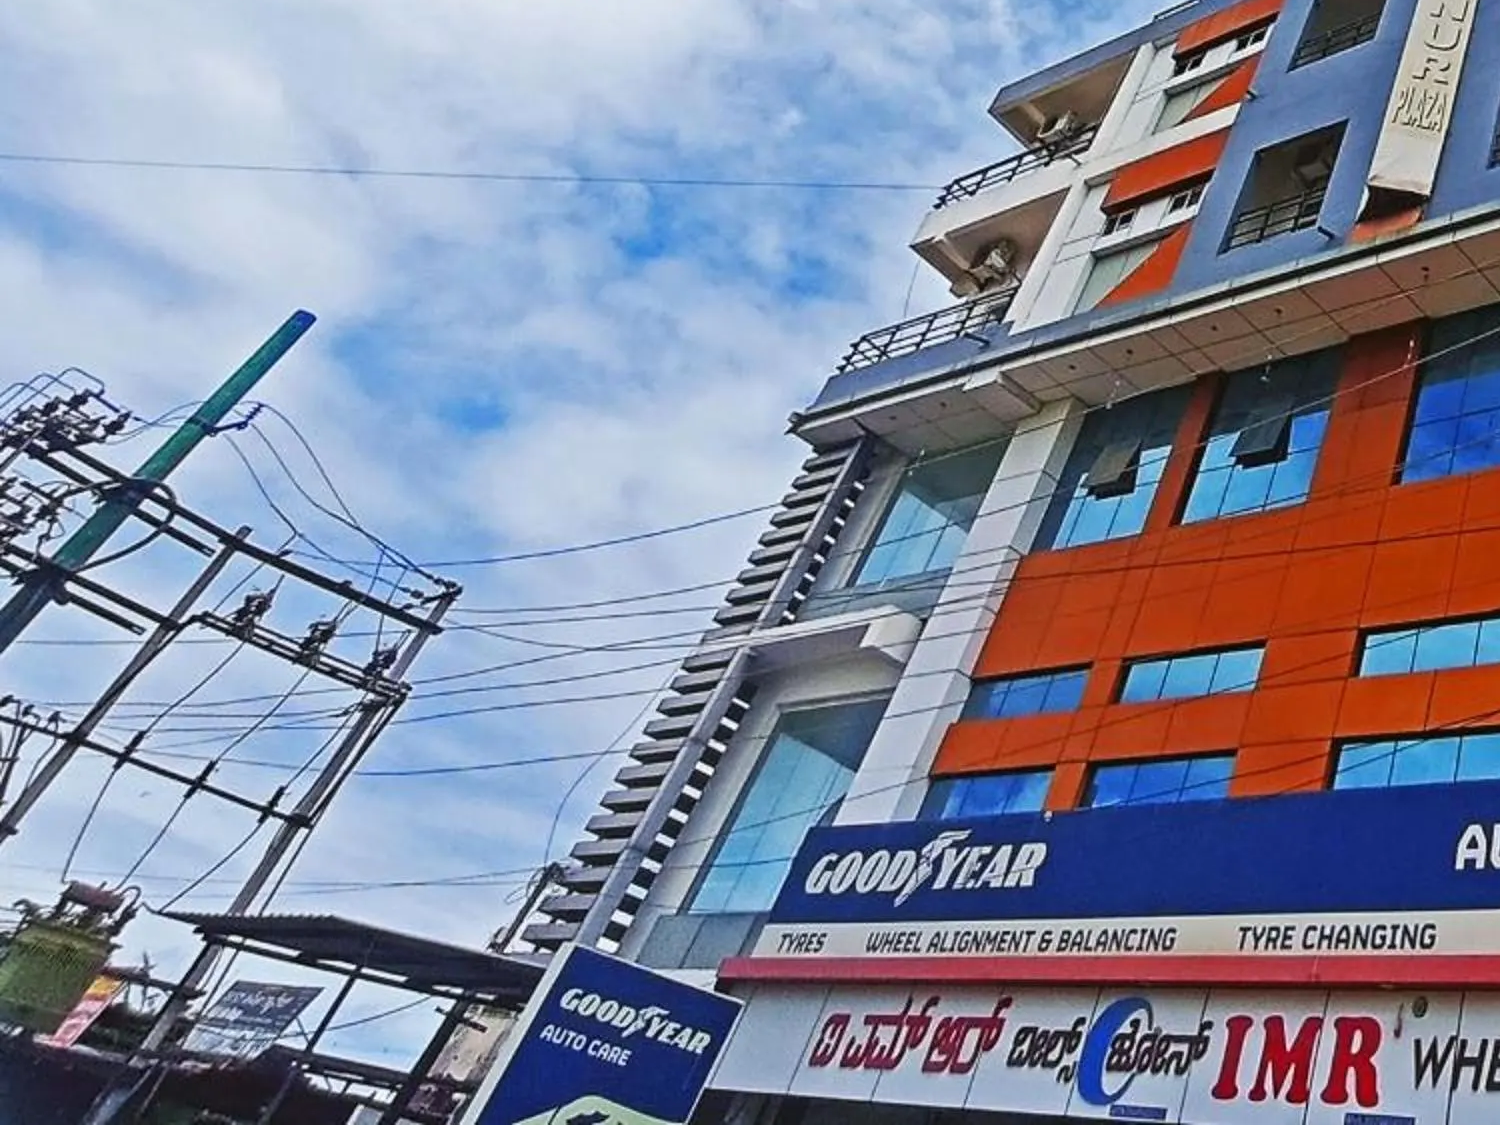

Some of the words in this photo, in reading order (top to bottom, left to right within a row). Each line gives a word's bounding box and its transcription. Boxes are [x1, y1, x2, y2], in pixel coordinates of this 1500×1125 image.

[1391, 86, 1447, 133] PLAZA
[804, 835, 1048, 899] GOODYEAR
[776, 932, 828, 954] TYRES
[865, 930, 922, 953] WHEEL
[926, 929, 1035, 953] ALIGNMENT
[1037, 930, 1053, 951] &
[1056, 926, 1178, 952] BALANCING
[1237, 925, 1296, 951] TYRE
[1302, 923, 1437, 950] CHANGING
[539, 1025, 586, 1051] AUTO
[587, 1040, 633, 1067] CARE
[559, 988, 712, 1055] GOODYEAR
[1211, 1014, 1382, 1108] IMR
